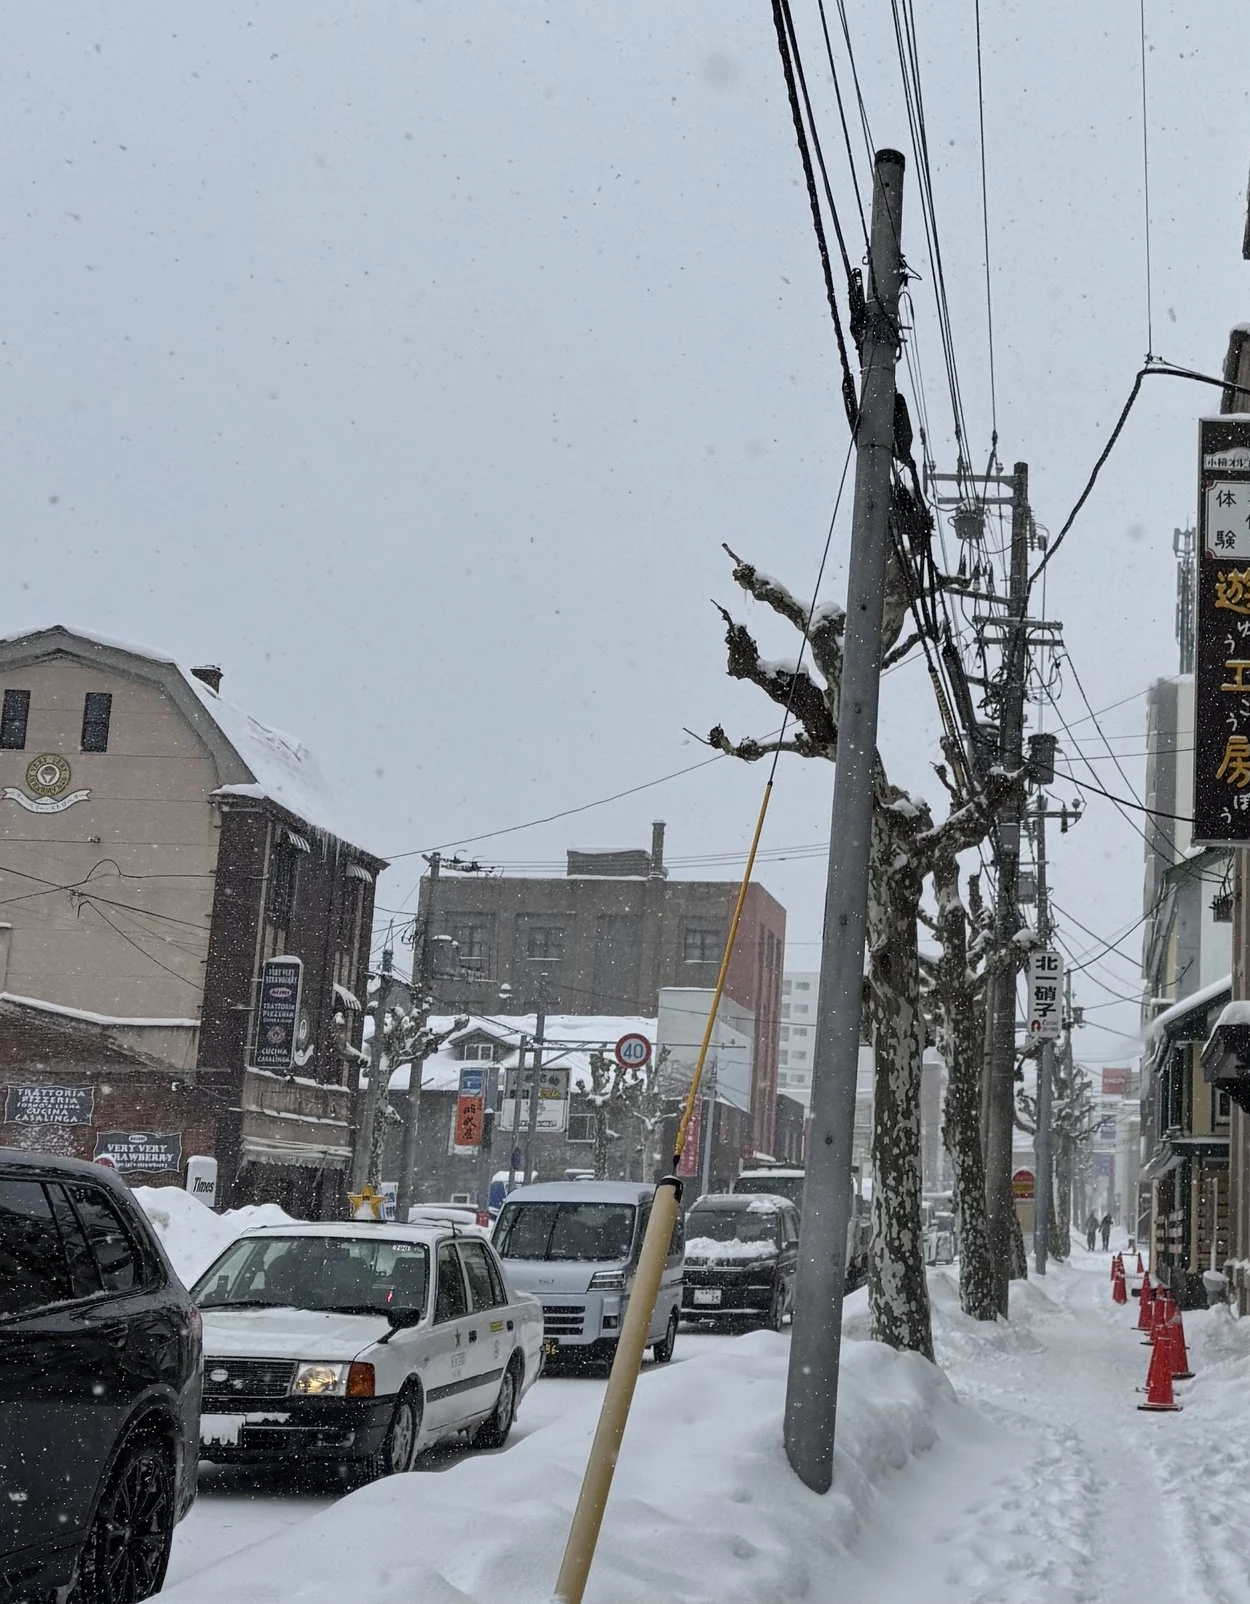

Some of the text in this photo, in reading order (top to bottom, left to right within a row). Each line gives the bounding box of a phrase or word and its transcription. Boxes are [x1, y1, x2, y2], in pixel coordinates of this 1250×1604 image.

[1214, 489, 1237, 549] 体験
[1034, 956, 1058, 1017] 北一硝子
[623, 1043, 643, 1059] 40
[17, 1088, 85, 1097] TRATTORIA
[21, 1095, 78, 1104] PIZZERIA
[26, 1107, 69, 1115] CUCINA
[15, 1114, 78, 1122] CASALINGA
[107, 1144, 168, 1153] VERY VERY
[193, 1176, 215, 1194] Times
